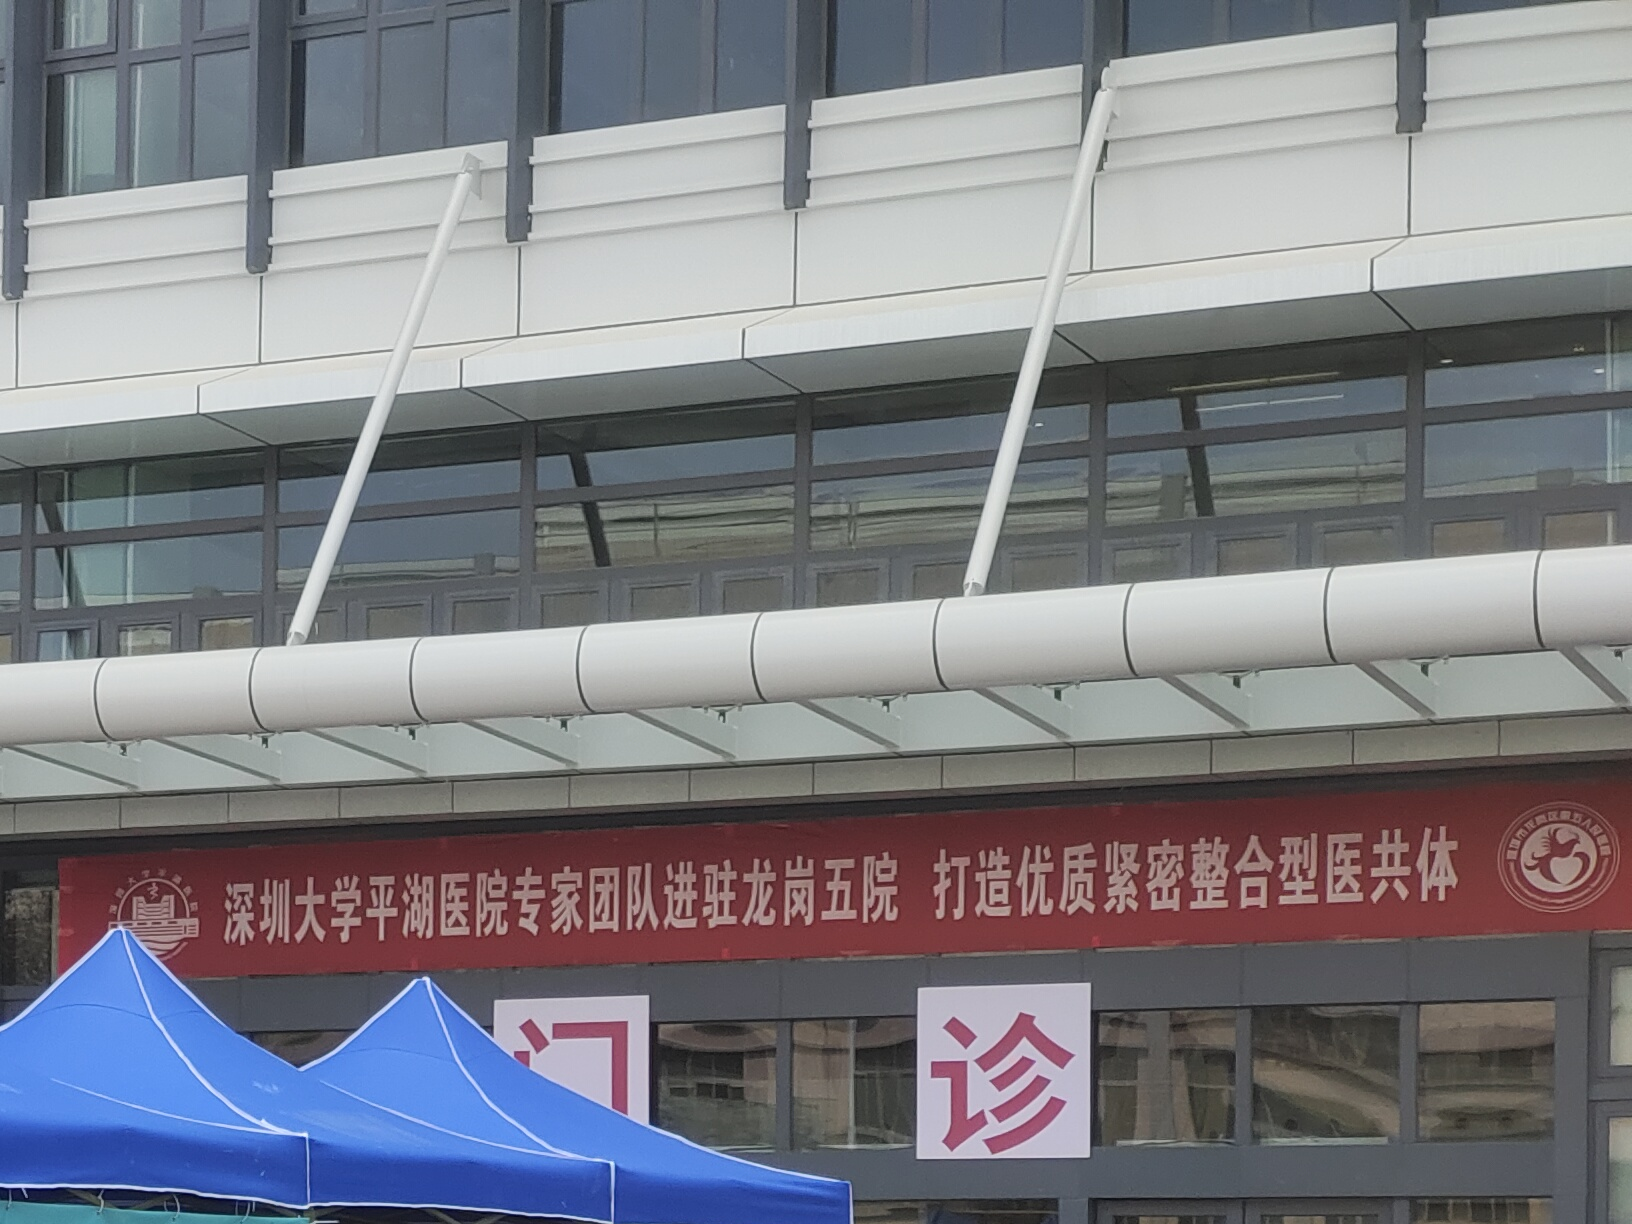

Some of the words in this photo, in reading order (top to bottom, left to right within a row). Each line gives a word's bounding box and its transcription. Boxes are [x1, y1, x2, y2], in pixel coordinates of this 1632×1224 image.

[223, 851, 899, 946] 深圳大学平湖医院专家团队进驻龙岗五院
[932, 826, 1460, 921] 打造优质紧密整合型医共体
[930, 1011, 1076, 1155] 诊
